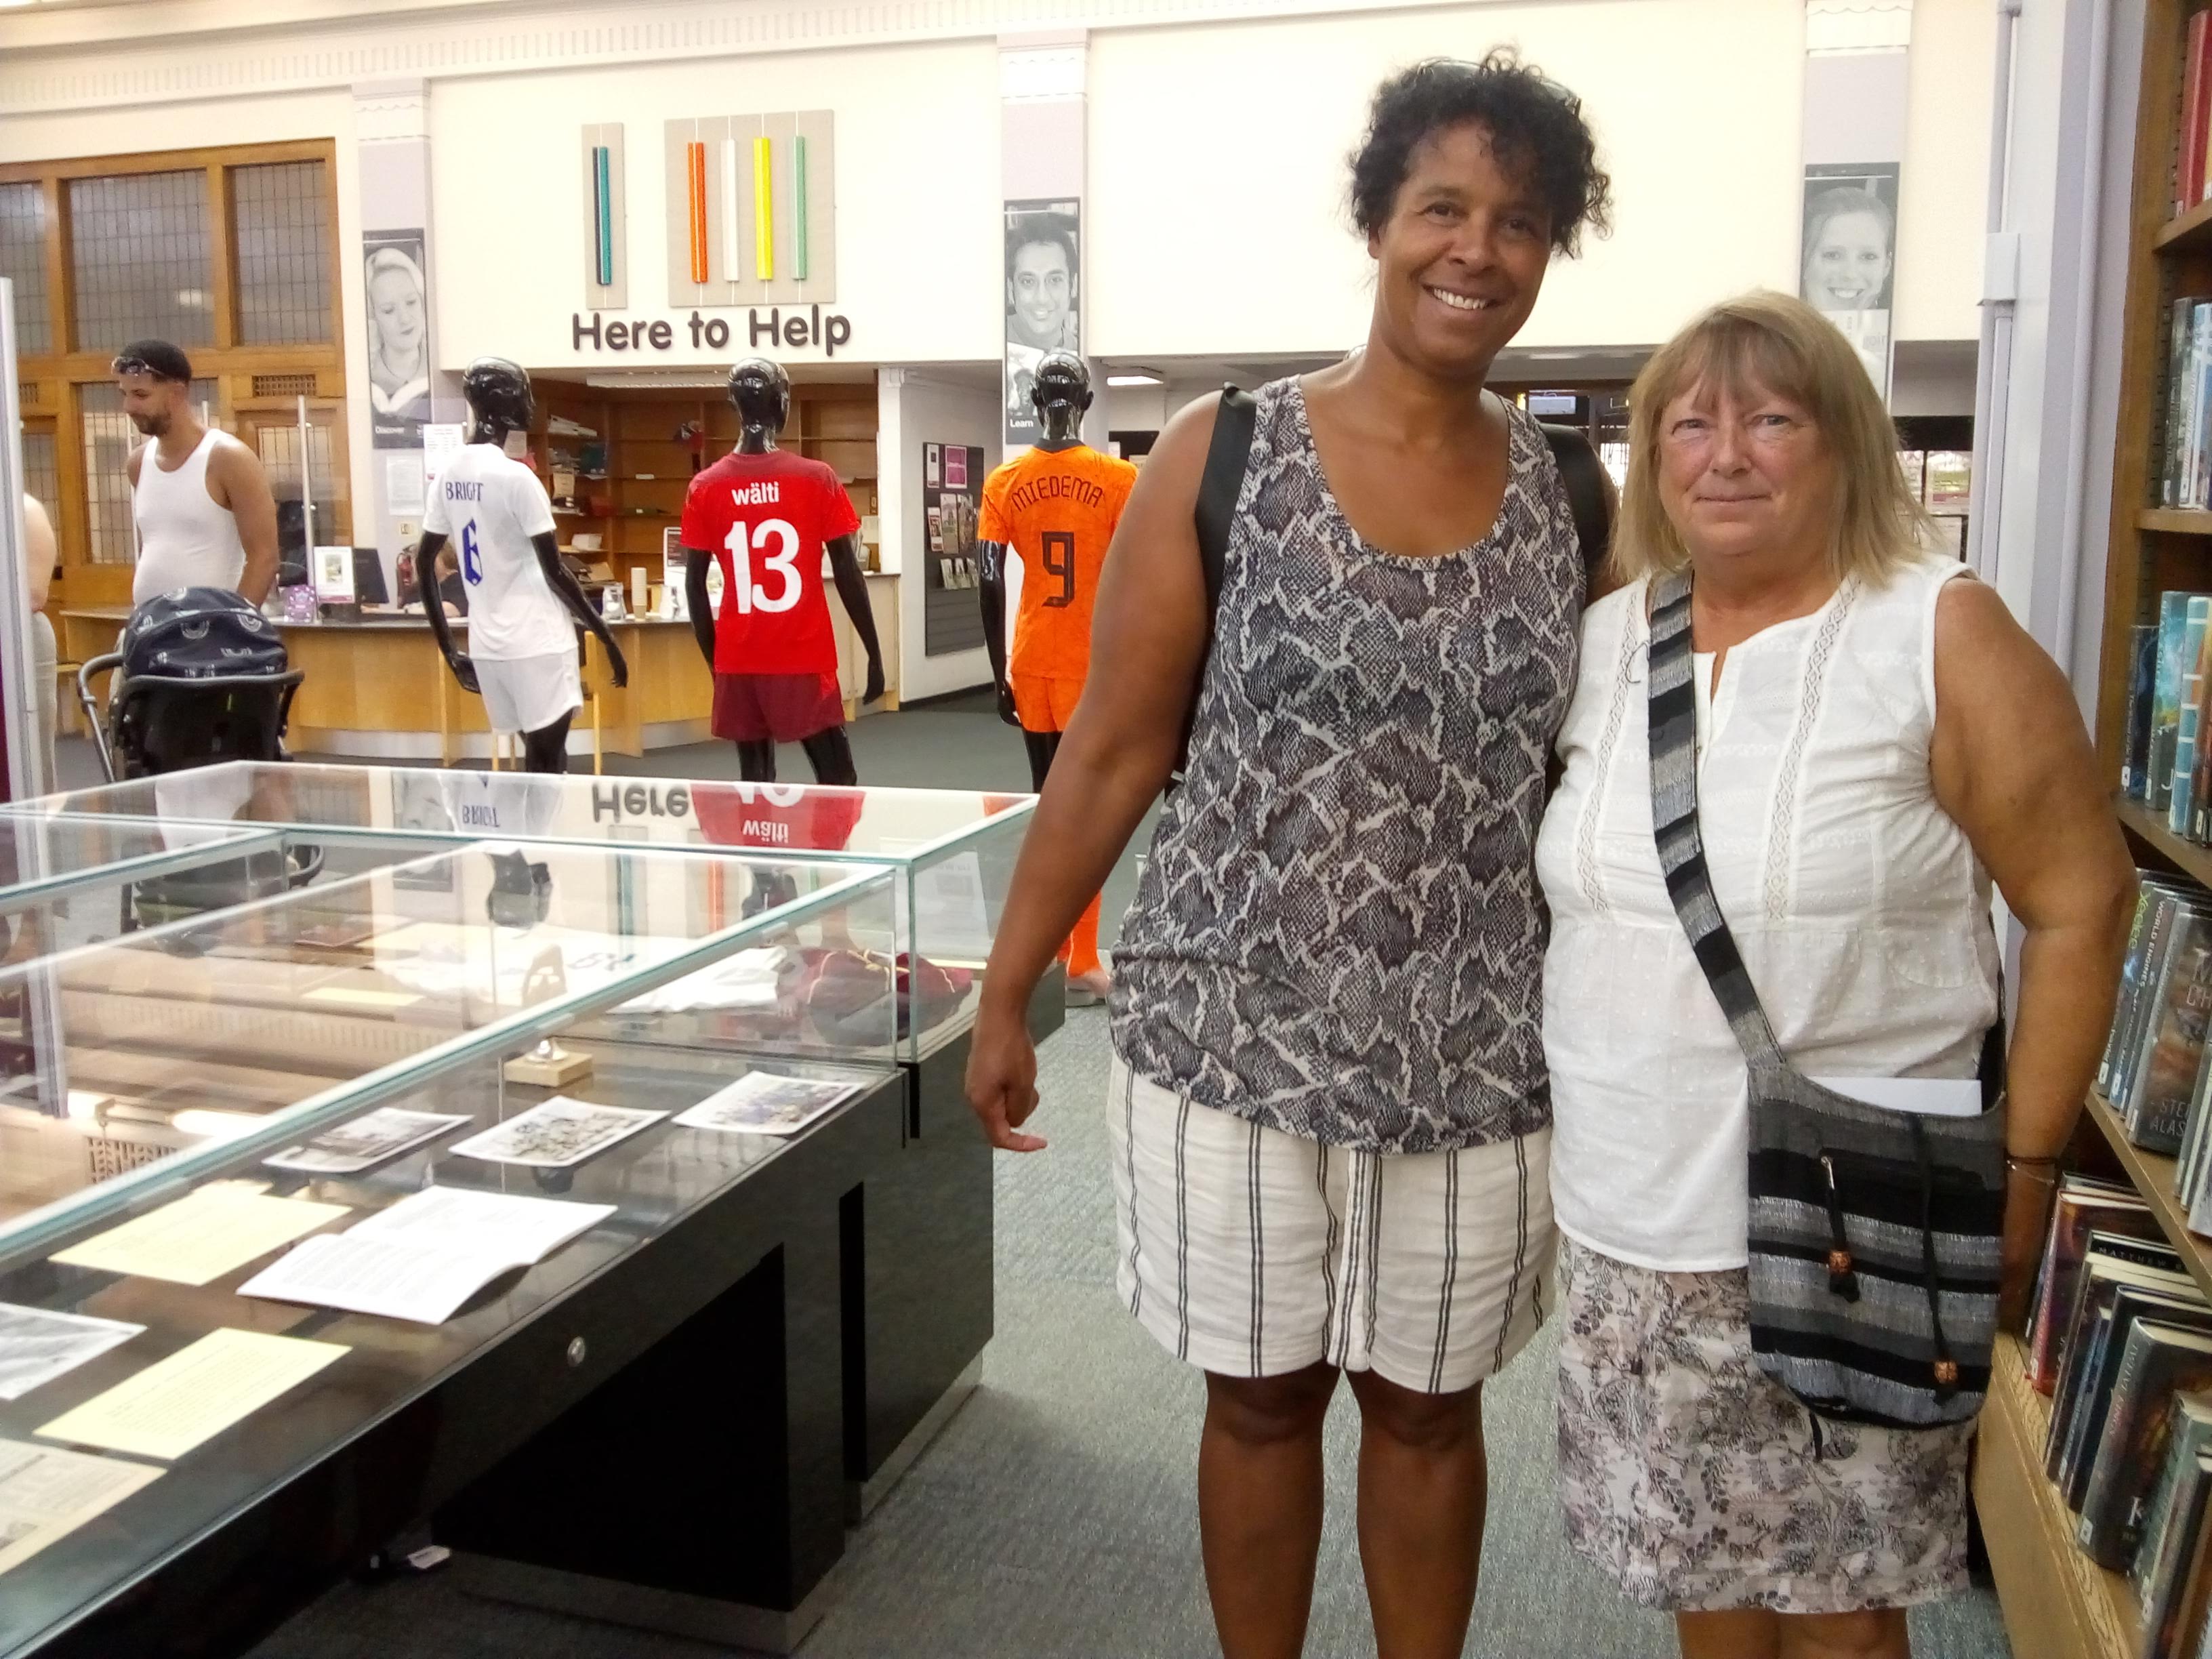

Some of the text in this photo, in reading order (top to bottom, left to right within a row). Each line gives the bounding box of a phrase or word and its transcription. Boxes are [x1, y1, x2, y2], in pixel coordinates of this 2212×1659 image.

[573, 303, 851, 356] Here to Help
[1010, 418, 1034, 428] Learn
[731, 481, 779, 506] wälti
[1010, 476, 1106, 512] MIEDEMA
[462, 516, 483, 586] 6
[724, 518, 802, 614] 13
[1041, 531, 1075, 608] 9
[2140, 900, 2165, 987] WORLD ENGINES
